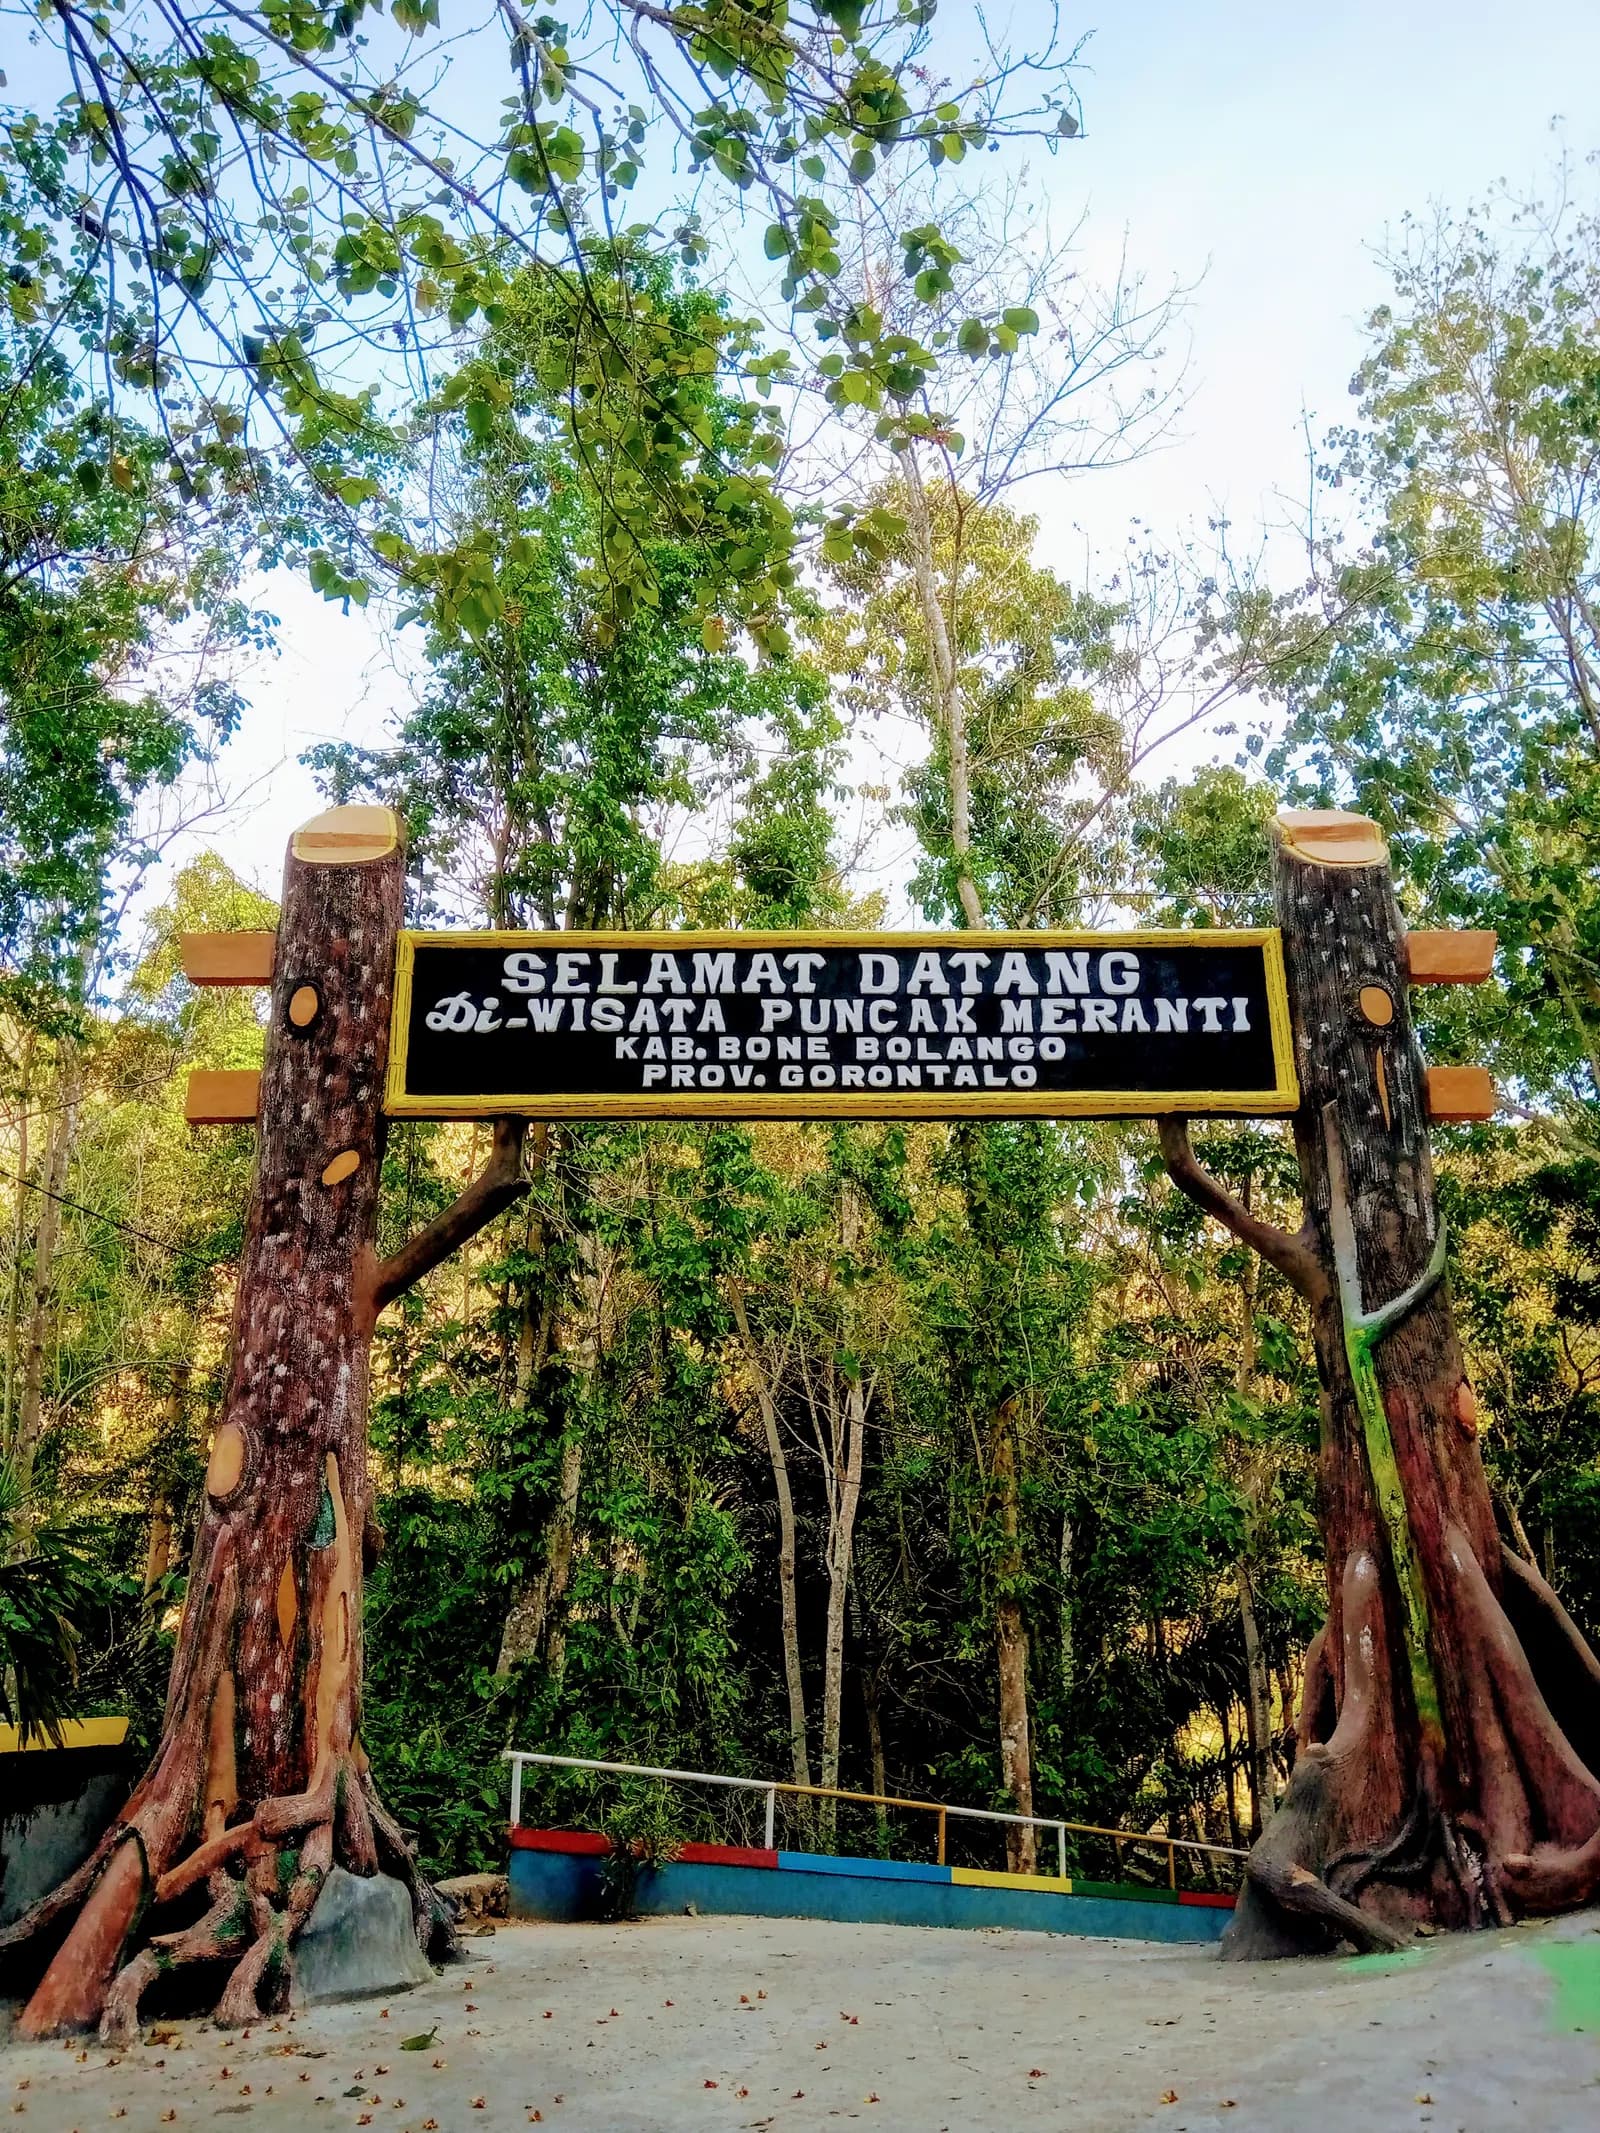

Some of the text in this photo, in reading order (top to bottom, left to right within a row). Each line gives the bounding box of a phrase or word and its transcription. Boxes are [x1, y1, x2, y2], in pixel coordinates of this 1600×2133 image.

[501, 952, 1140, 995] SELAMAT DATANG
[759, 998, 978, 1034] PUNCAK
[1000, 997, 1251, 1034] MERANTI
[615, 1036, 1066, 1062] KAB. BONE BOLANGO
[642, 1064, 1037, 1087] PROV. GORONTALO
